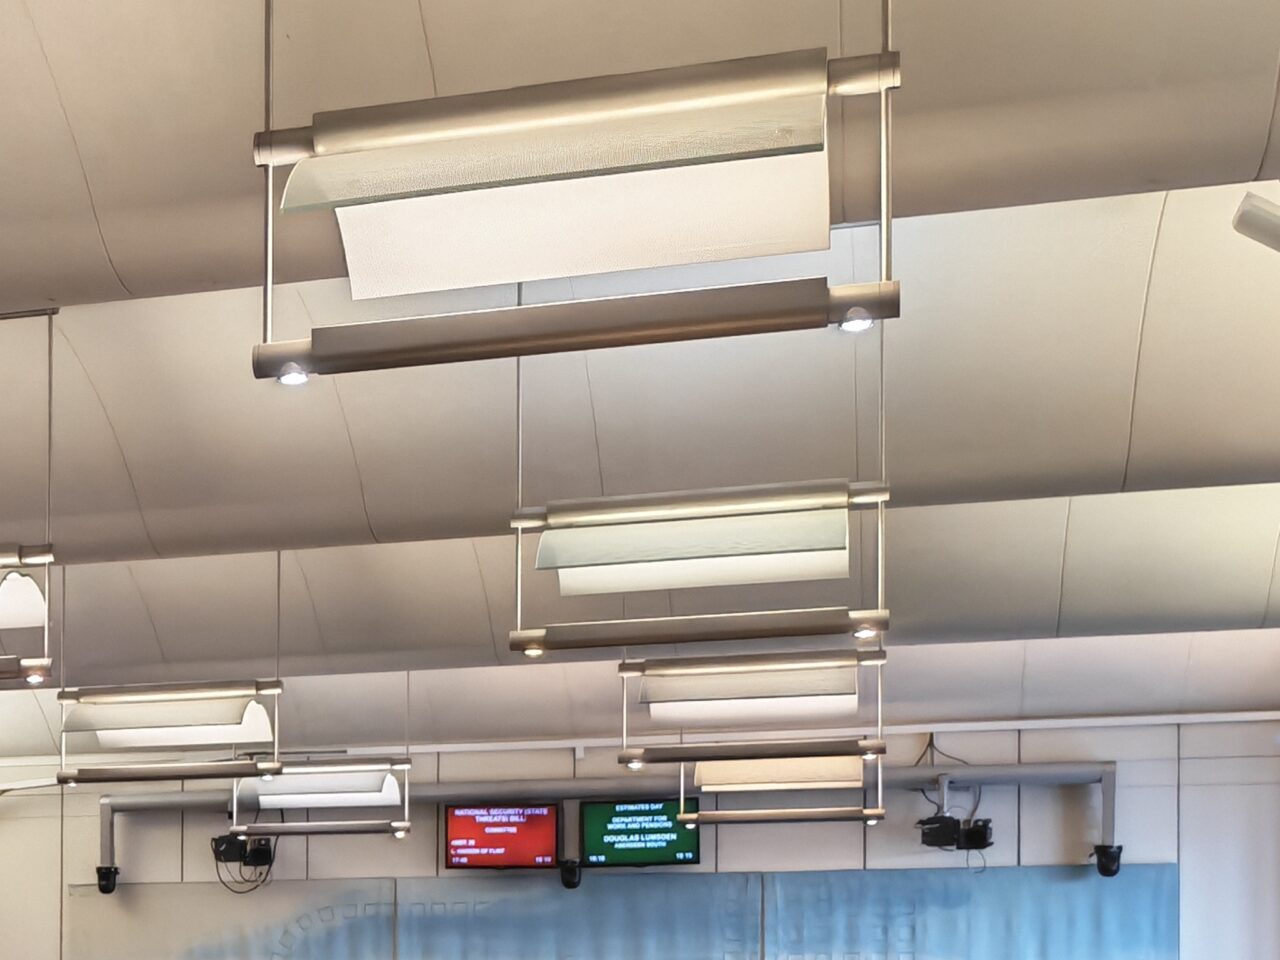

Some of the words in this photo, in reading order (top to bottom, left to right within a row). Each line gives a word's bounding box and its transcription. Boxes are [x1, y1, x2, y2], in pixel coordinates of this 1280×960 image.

[615, 803, 650, 811] ESTIMATES
[454, 808, 488, 816] NATIONAL
[611, 815, 653, 823] DEPARTMENT
[641, 821, 673, 829] PENSIONS
[603, 834, 640, 842] DOUGLAS
[640, 833, 677, 841] LUMSDEN
